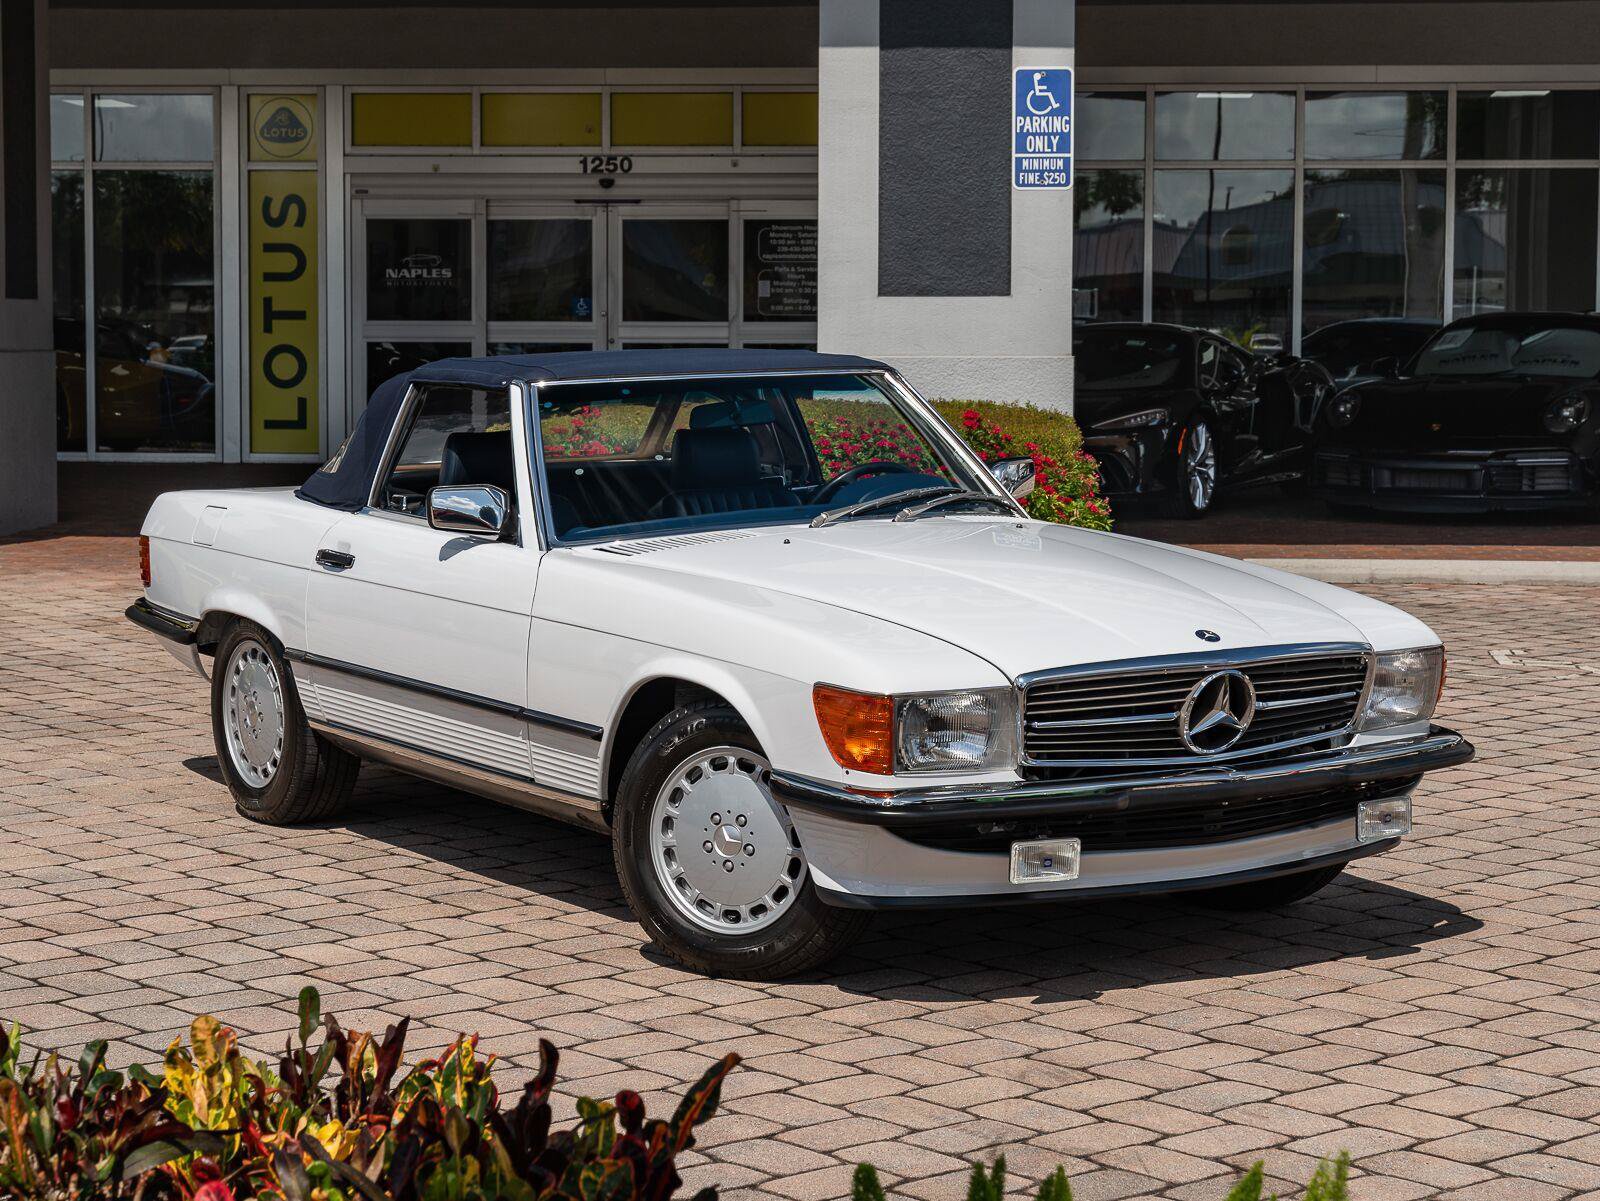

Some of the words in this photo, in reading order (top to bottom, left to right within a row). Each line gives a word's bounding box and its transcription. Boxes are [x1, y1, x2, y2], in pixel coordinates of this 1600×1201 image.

[264, 127, 305, 138] LOTUS
[1016, 116, 1070, 133] PARKING
[1026, 135, 1060, 153] ONLY
[579, 155, 633, 174] 1250
[1022, 158, 1064, 170] MINIMUM
[1019, 172, 1041, 184] FINE
[1043, 171, 1066, 186] $250
[385, 267, 453, 279] NAPLES
[262, 193, 308, 430] LOTUS
